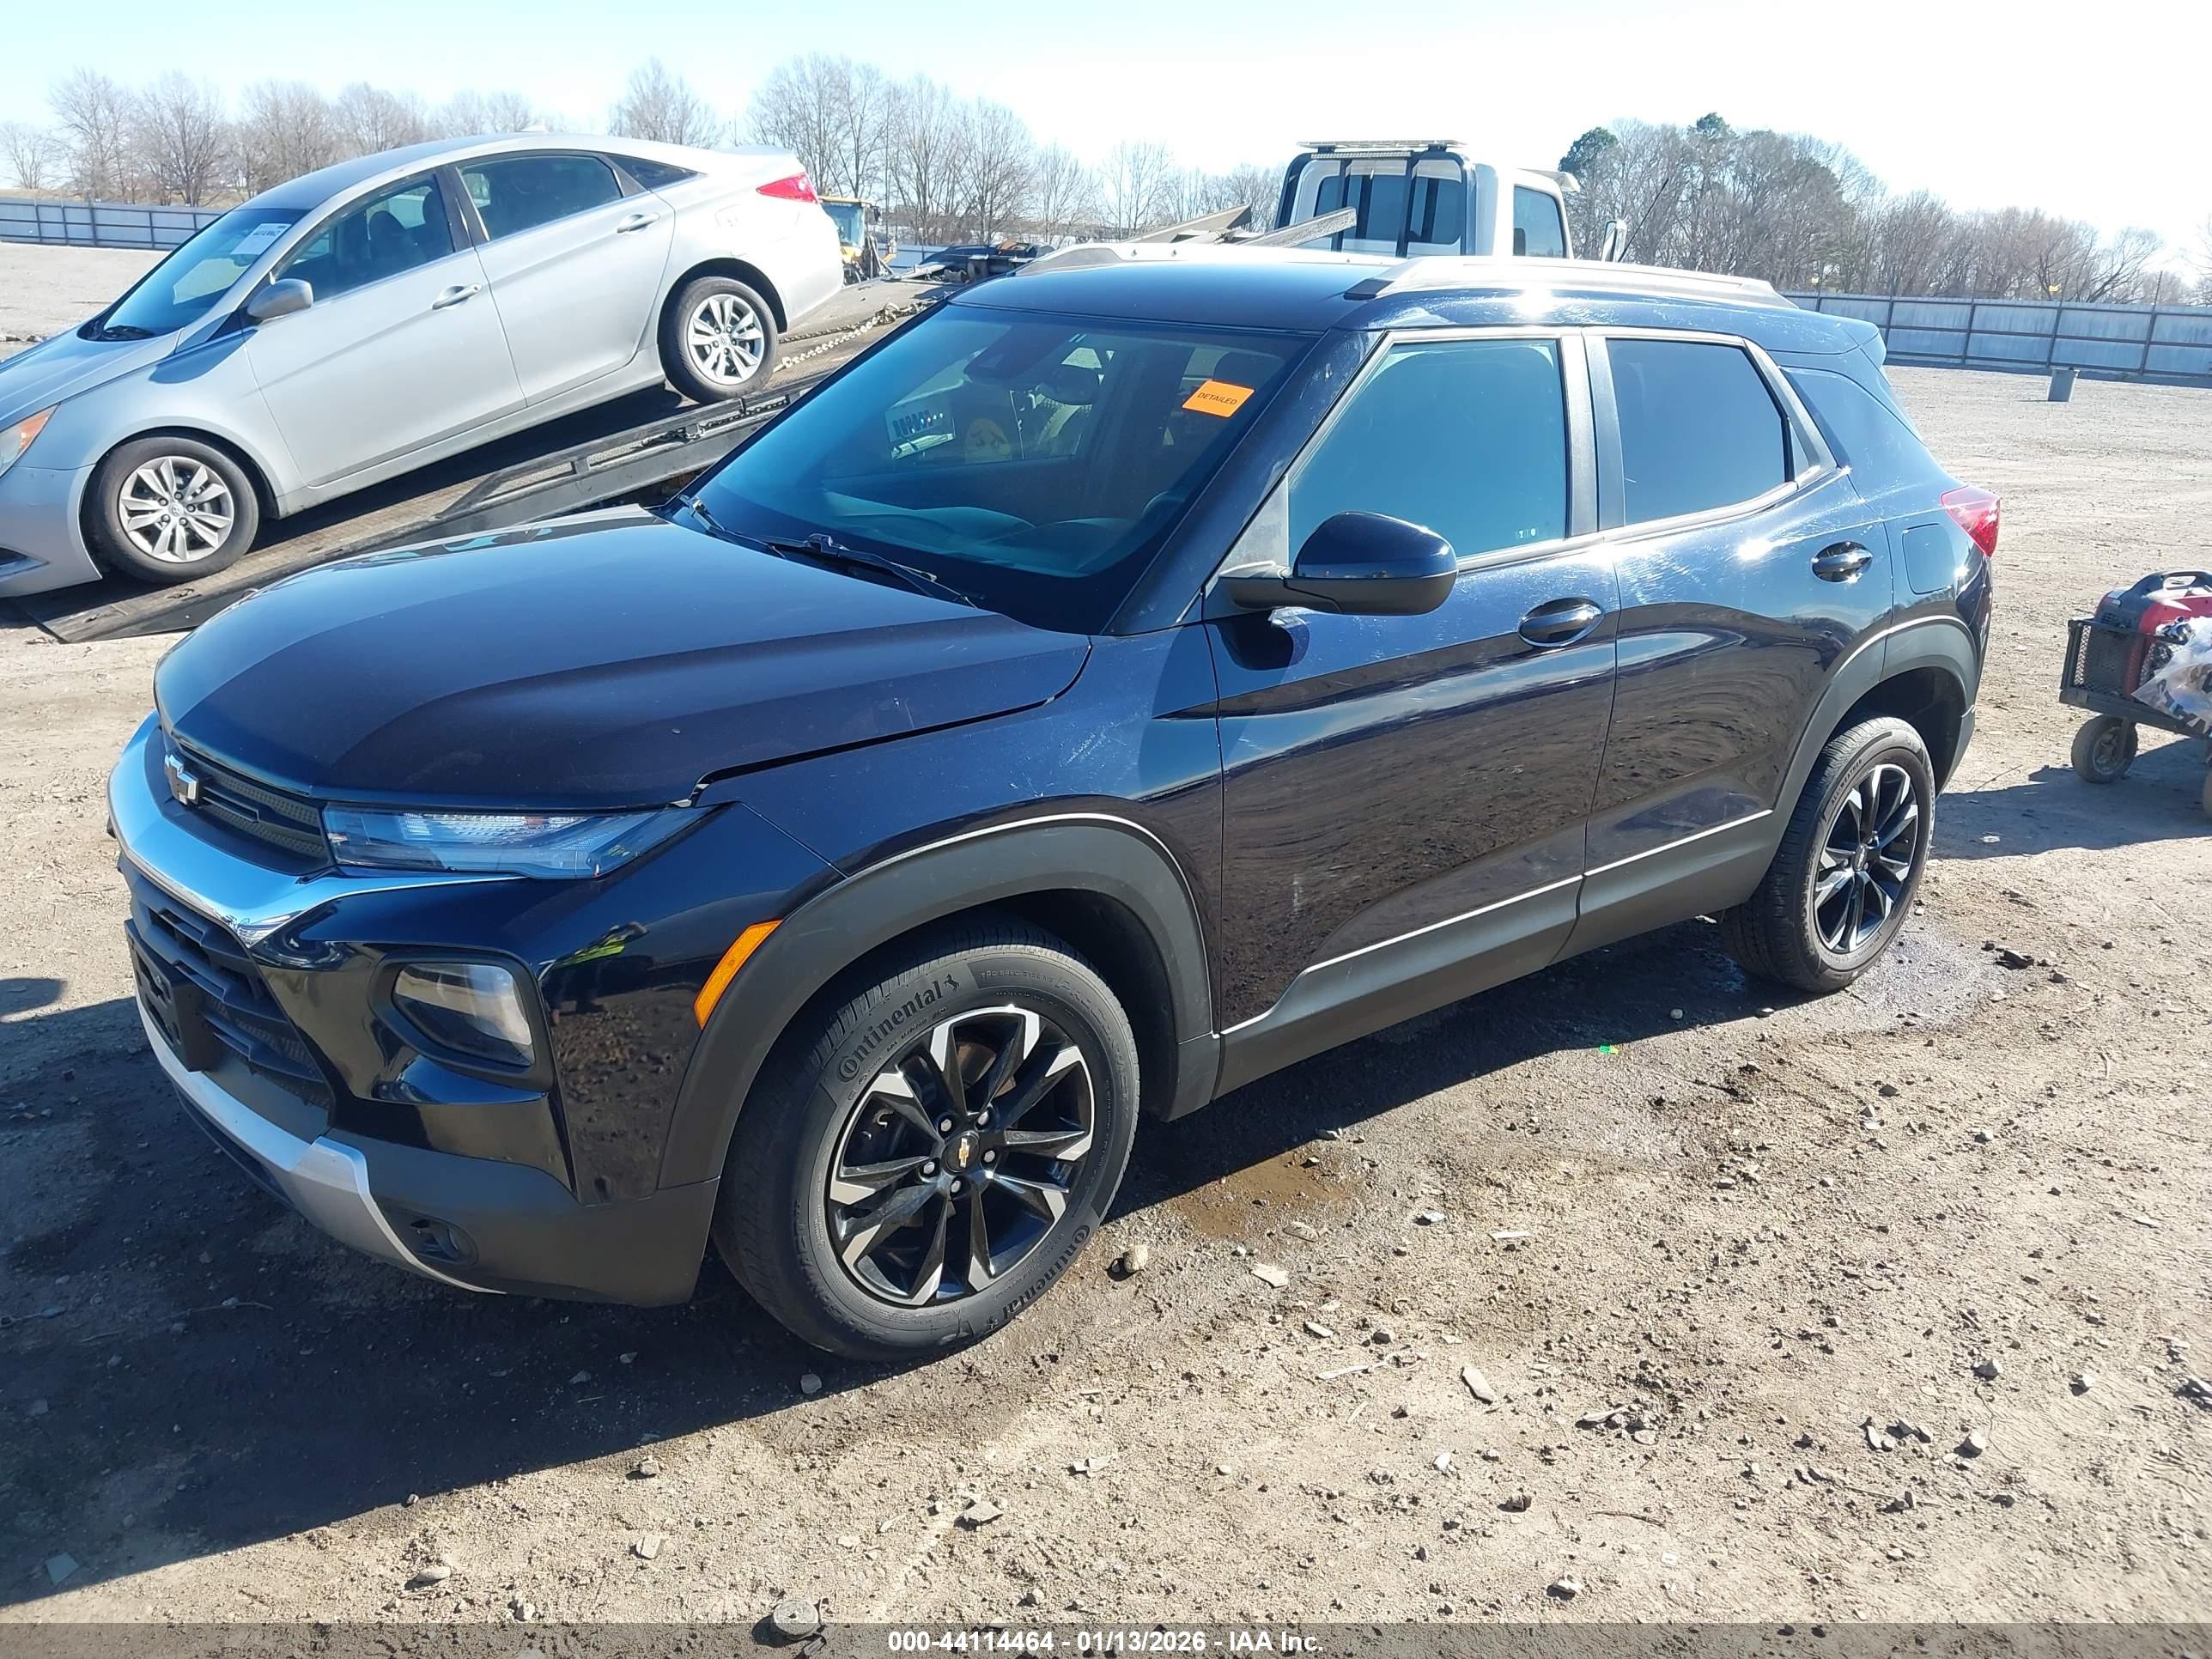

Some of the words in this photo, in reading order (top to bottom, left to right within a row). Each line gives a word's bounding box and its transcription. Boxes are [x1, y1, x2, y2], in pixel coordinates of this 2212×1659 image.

[1197, 392, 1237, 405] DETAILED
[837, 981, 944, 1083] Continental
[1003, 1224, 1091, 1320] Continental
